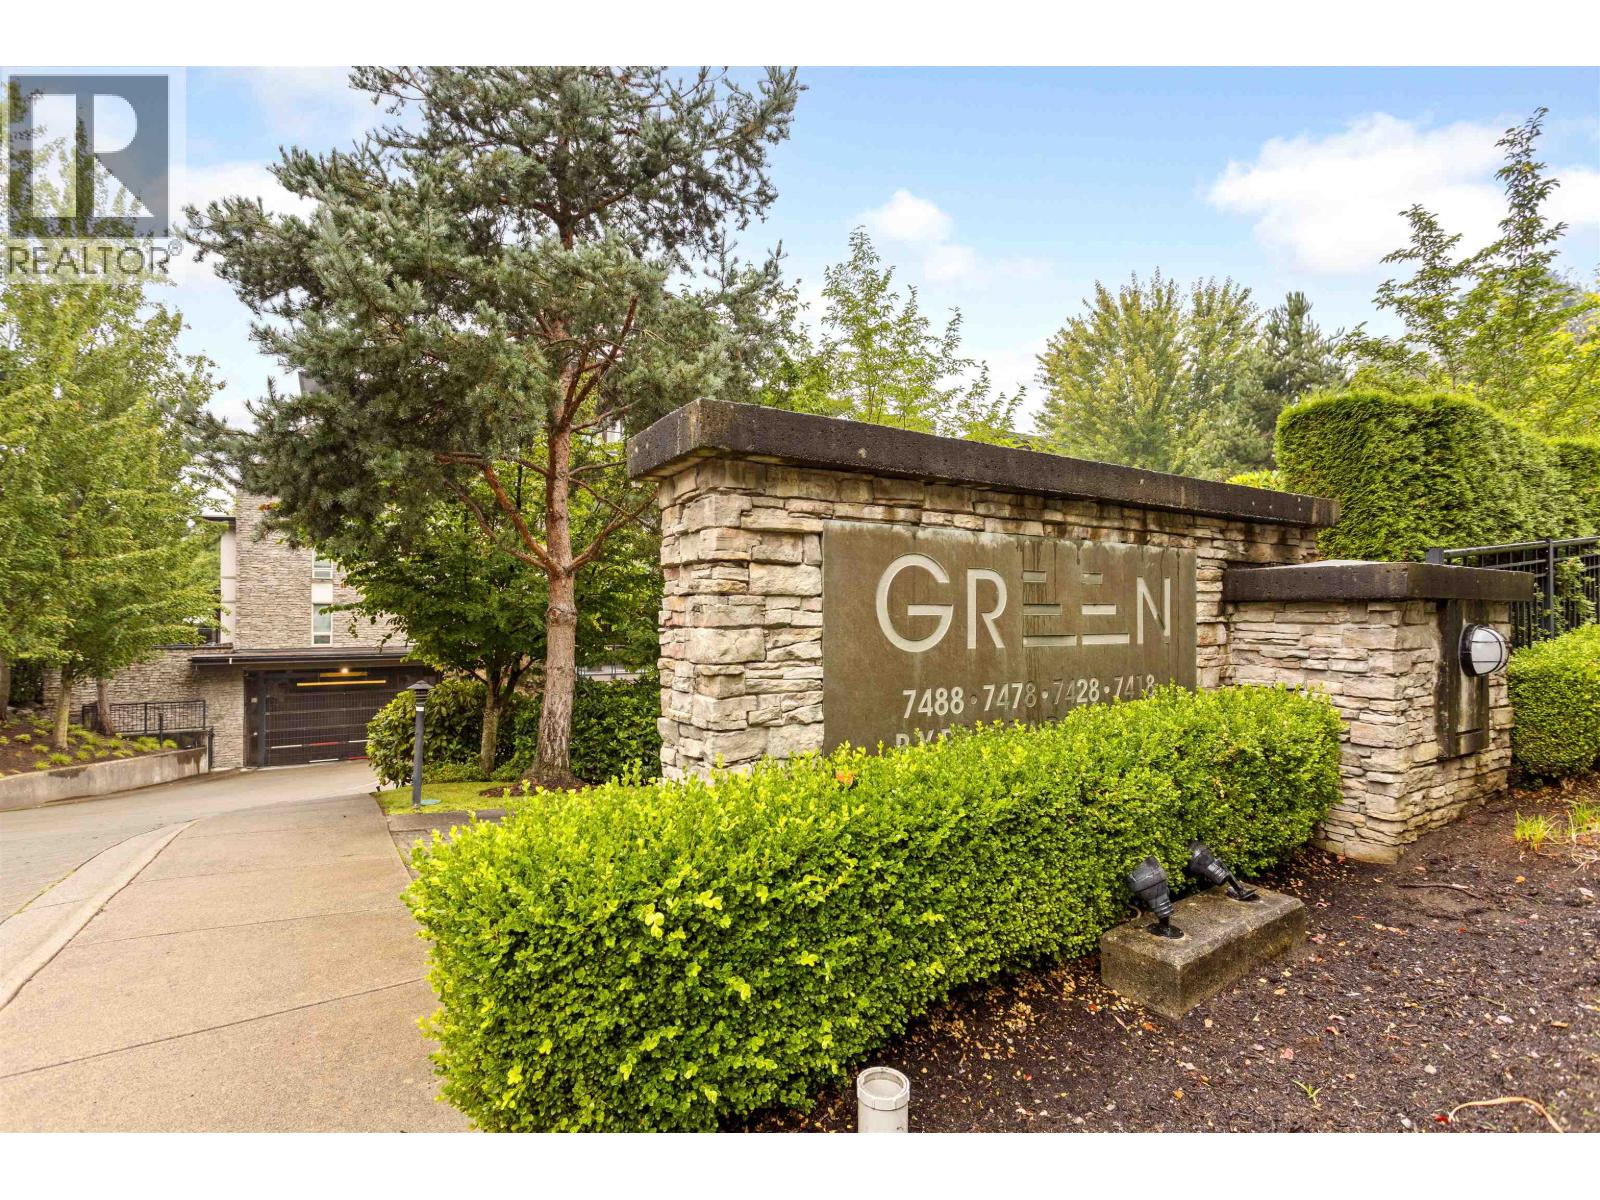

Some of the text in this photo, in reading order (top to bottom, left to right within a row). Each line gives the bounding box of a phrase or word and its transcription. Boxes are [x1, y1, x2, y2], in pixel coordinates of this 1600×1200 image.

[876, 552, 1170, 652] GREEN
[903, 674, 1155, 718] 7488 7478 7428 7418
